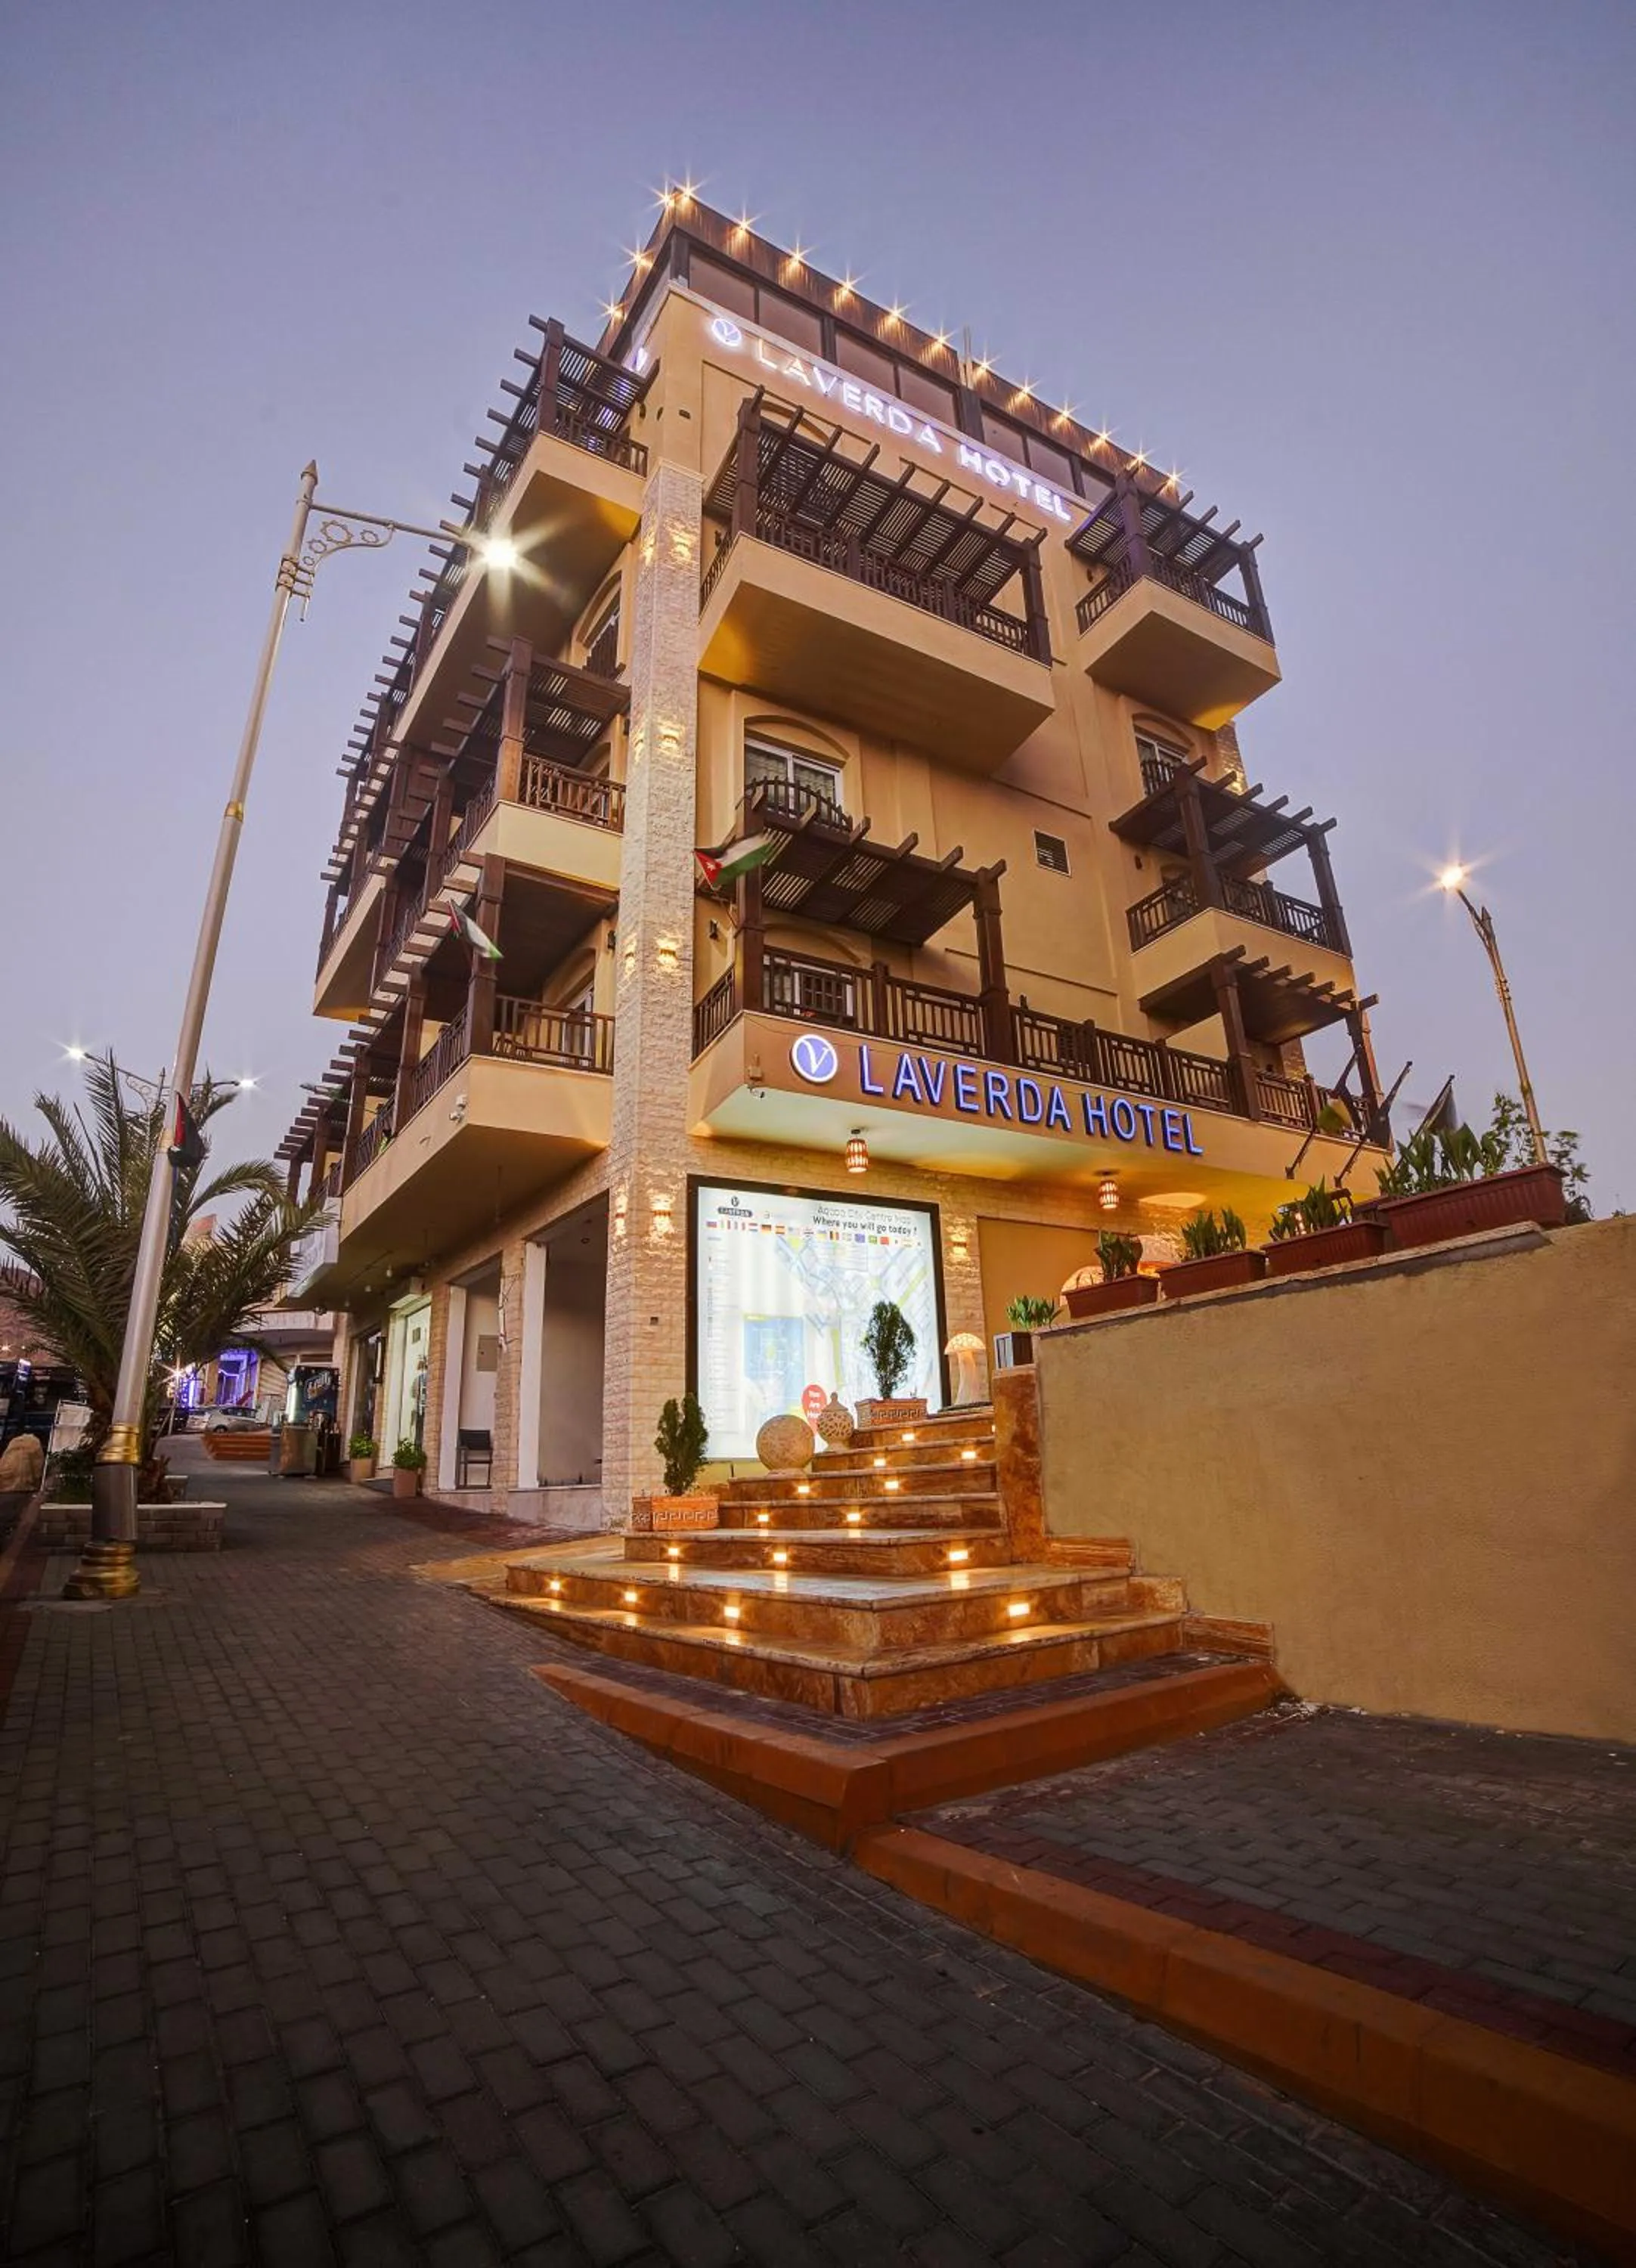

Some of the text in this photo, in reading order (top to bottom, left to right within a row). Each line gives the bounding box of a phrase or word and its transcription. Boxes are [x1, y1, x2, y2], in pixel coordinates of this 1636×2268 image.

[758, 338, 943, 454] LAVERDA
[959, 444, 1071, 522] HOTEL
[859, 1043, 1071, 1132] LAVERDA
[1083, 1092, 1204, 1156] HOTEL
[813, 1215, 841, 1227] Where
[842, 1220, 858, 1230] you
[860, 1222, 875, 1232] will
[876, 1224, 887, 1235] go
